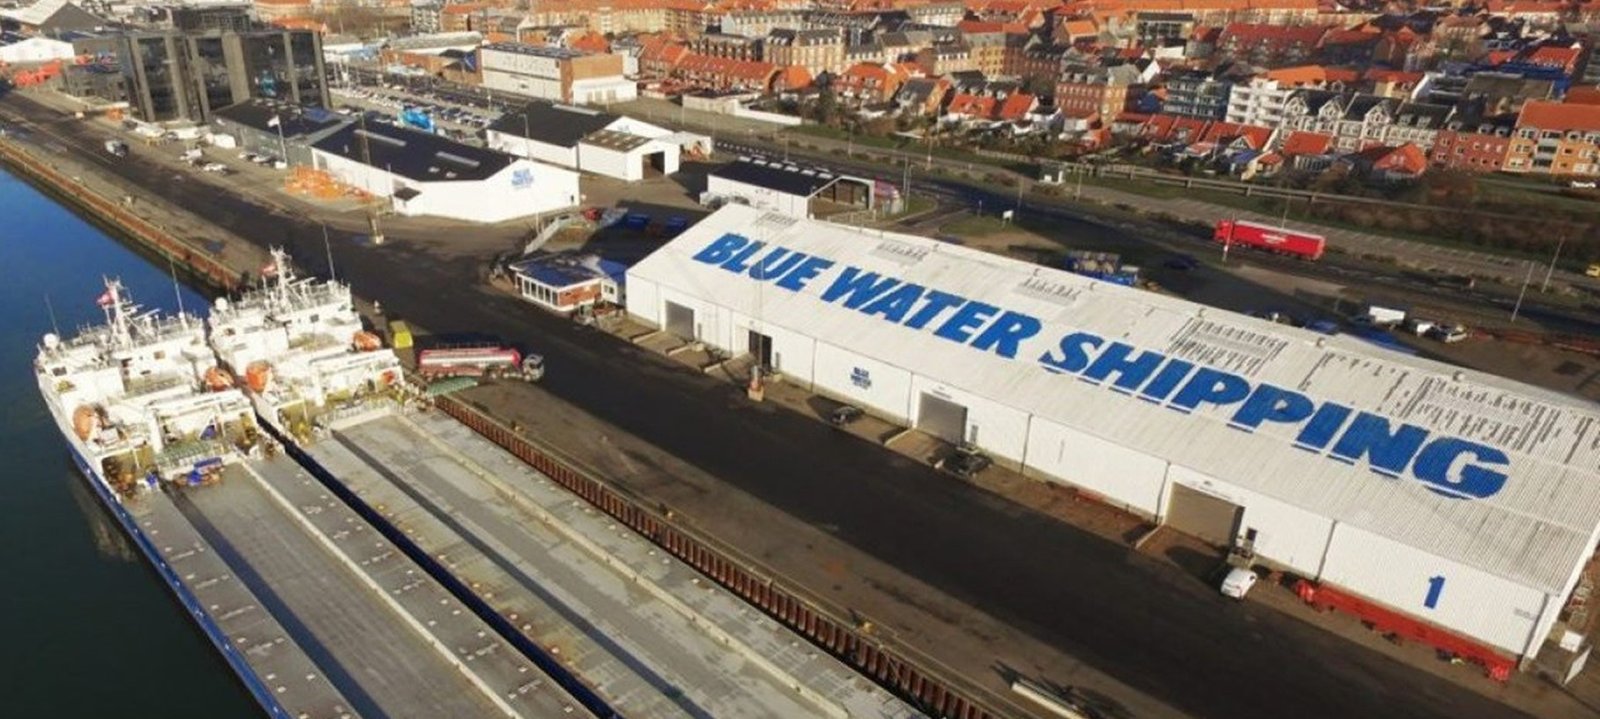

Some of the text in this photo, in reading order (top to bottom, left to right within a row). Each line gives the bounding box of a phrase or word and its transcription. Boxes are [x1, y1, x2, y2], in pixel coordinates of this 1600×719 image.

[692, 232, 1509, 499] BLUE WATER SHIPPING
[1424, 575, 1445, 609] 1
